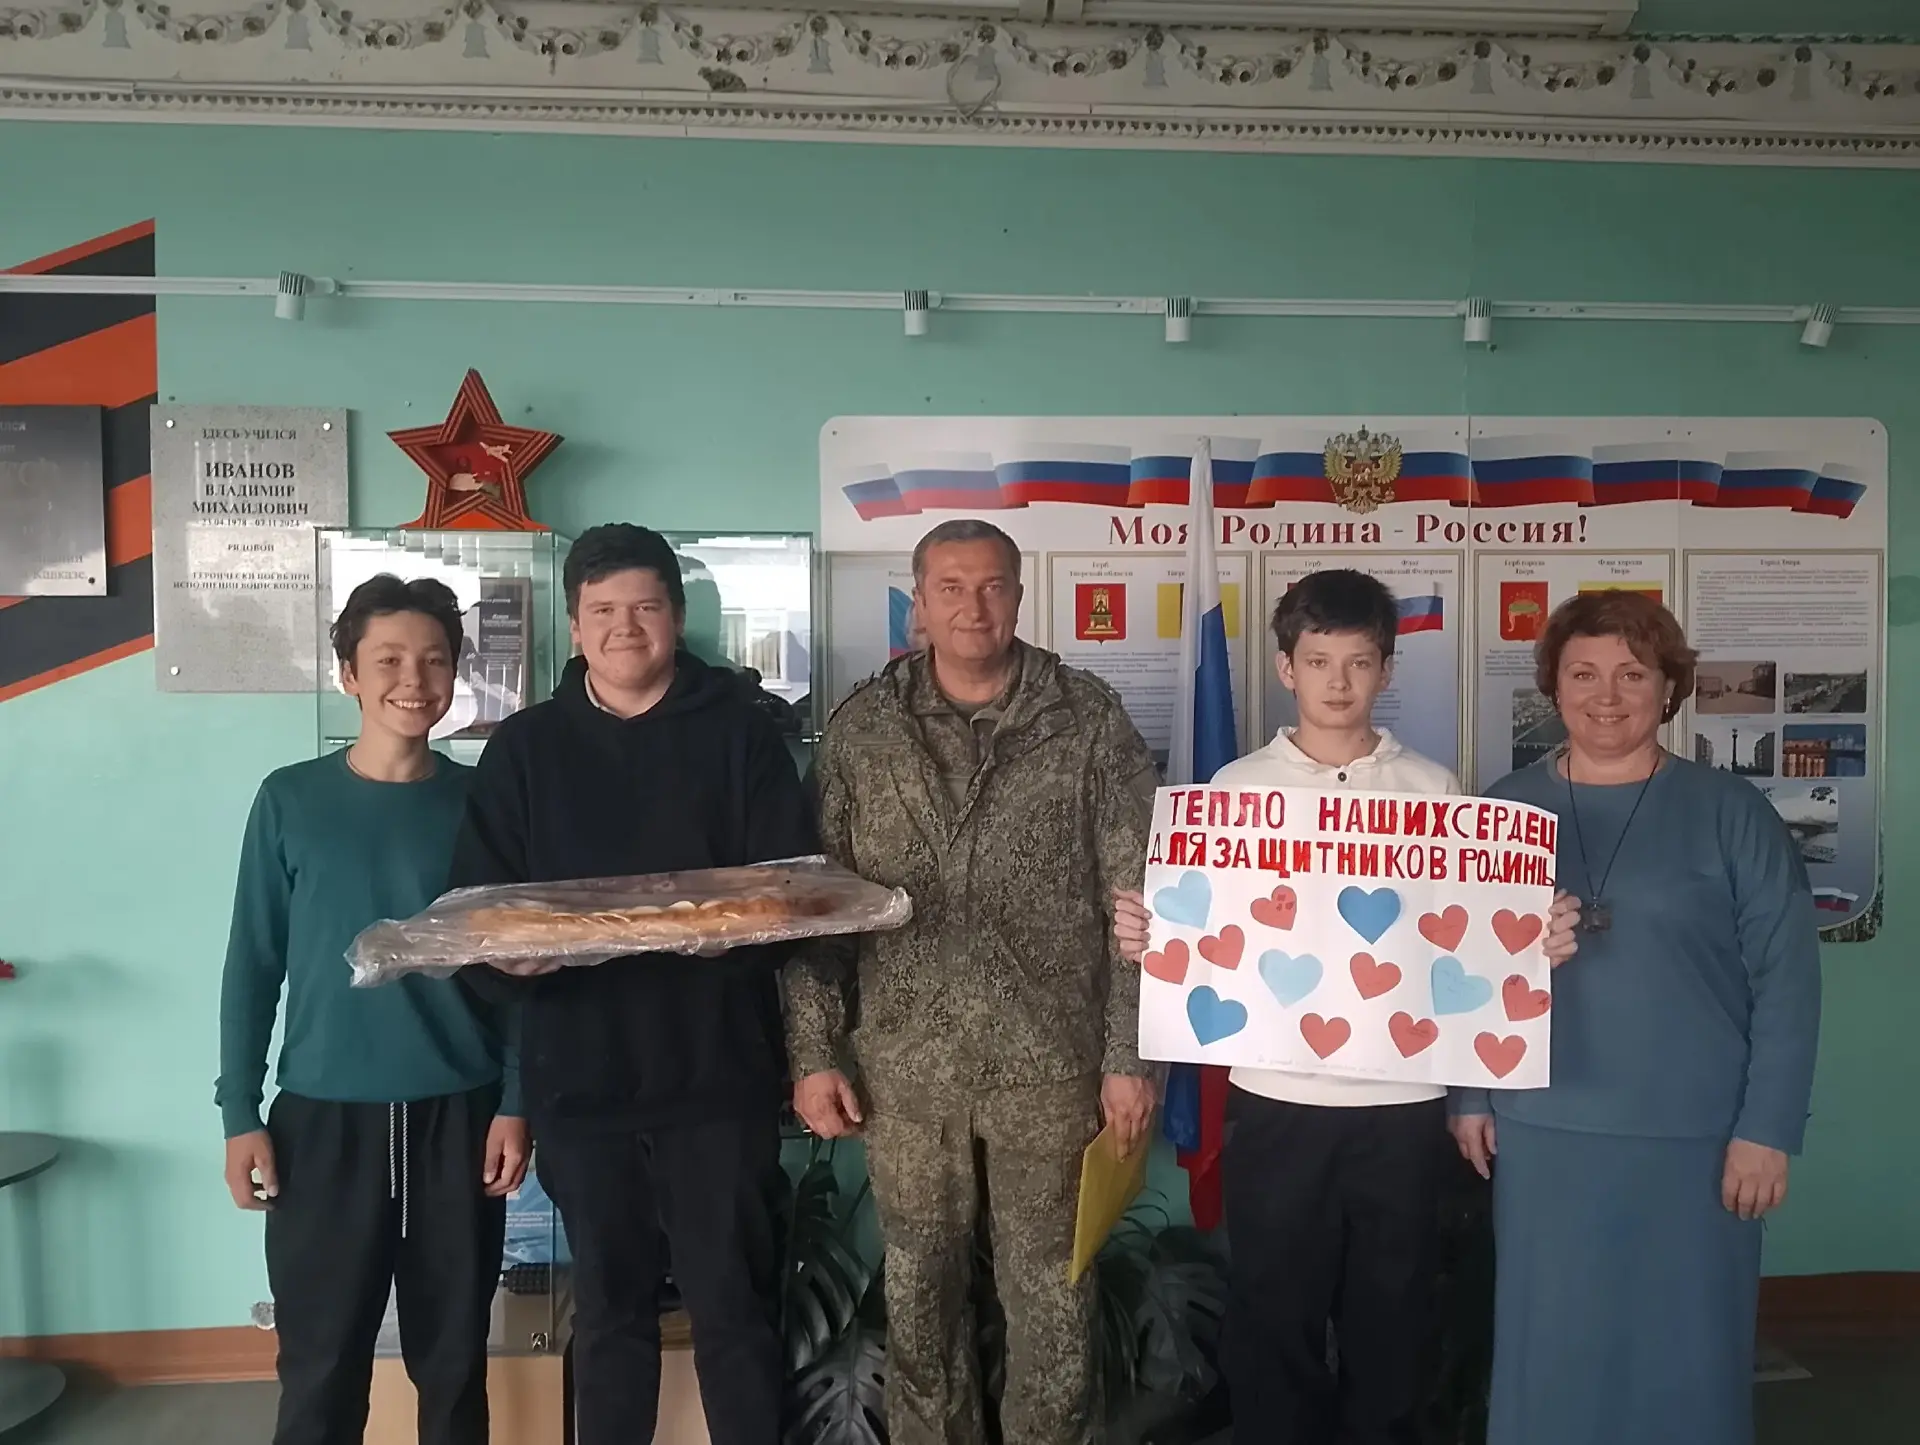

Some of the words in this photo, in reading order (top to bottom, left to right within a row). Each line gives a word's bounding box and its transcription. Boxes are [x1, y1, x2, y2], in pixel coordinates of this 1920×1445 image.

[202, 428, 240, 440] ЗДЕСЬ
[244, 428, 297, 440] УЧИЛСЯ
[205, 461, 296, 479] ИВАНОВ
[205, 483, 296, 498] ВЛАДИМИР
[192, 501, 309, 515] МИХАЙЛОВИЧ
[1221, 518, 1382, 549] Родина
[1415, 513, 1588, 544] Россия!
[1169, 790, 1286, 830] ТЕПЛО
[1458, 848, 1556, 887] РОДИНЫ
